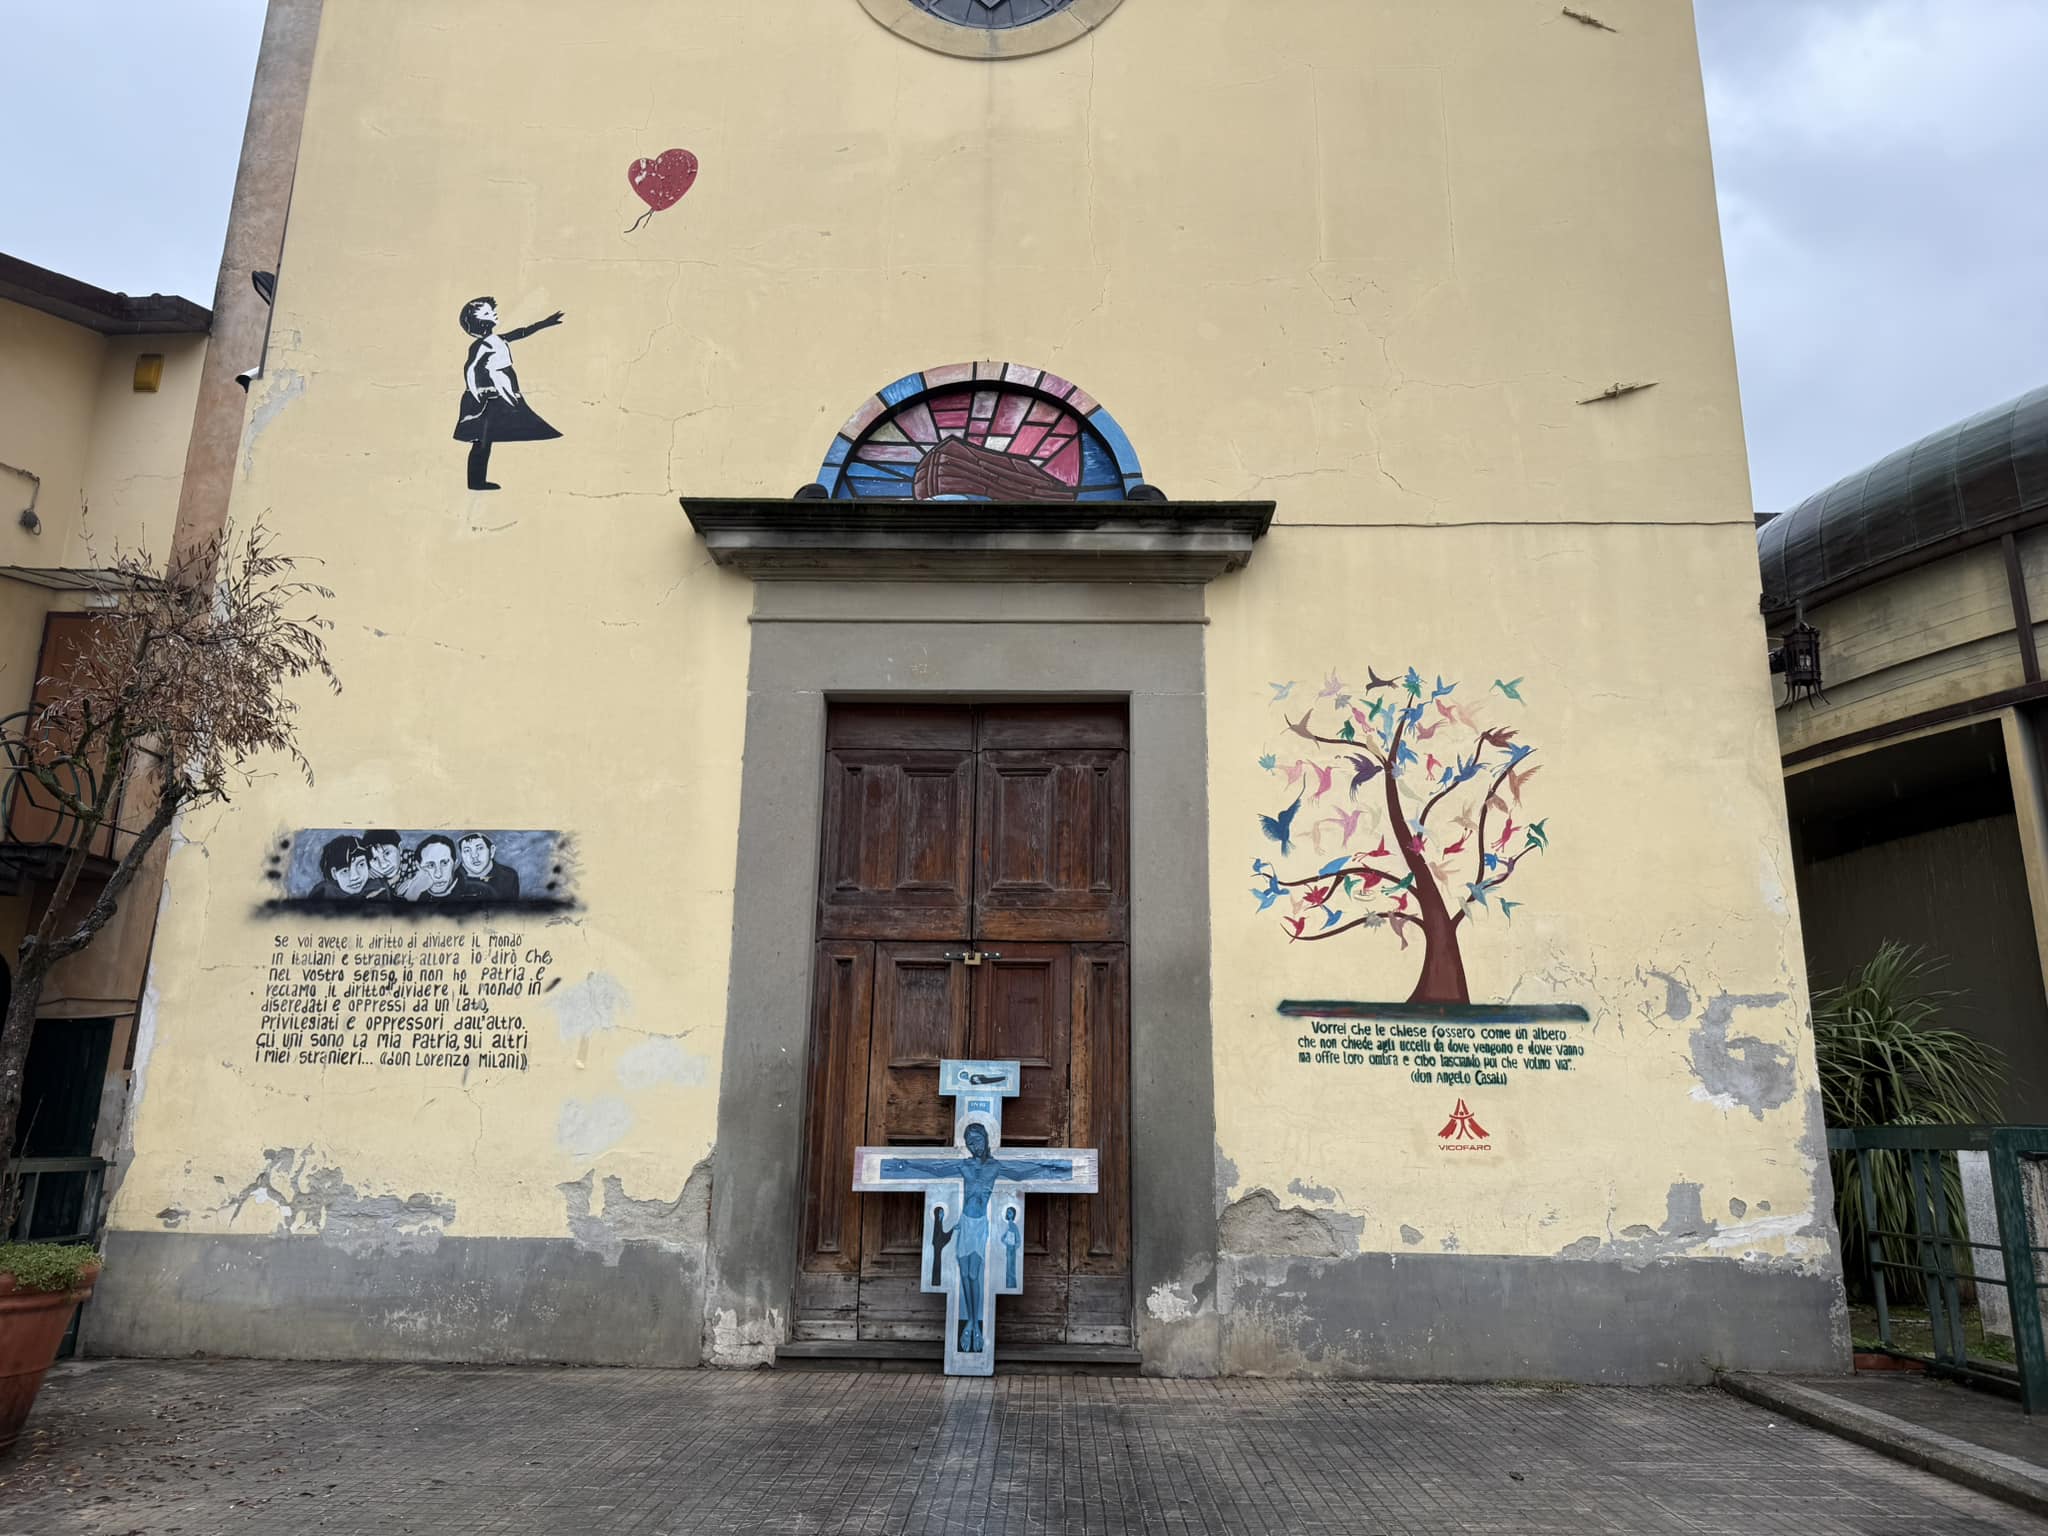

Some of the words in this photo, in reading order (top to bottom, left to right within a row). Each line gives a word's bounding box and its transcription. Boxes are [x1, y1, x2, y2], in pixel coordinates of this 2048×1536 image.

[298, 933, 313, 948] voi
[318, 936, 348, 951] avete
[368, 934, 403, 949] diritto
[407, 932, 417, 948] di
[422, 932, 465, 948] dividere
[271, 952, 284, 965] in
[291, 950, 336, 965] italiani
[341, 953, 349, 966] e
[419, 952, 460, 966] allora
[471, 951, 482, 965] io
[269, 968, 291, 981] nel
[302, 969, 344, 981] vostro
[403, 966, 413, 982] io
[420, 969, 443, 981] non
[453, 968, 467, 981] ho
[536, 966, 546, 981] e
[328, 982, 337, 997] il
[343, 982, 386, 998] diritto
[393, 981, 448, 998] dividere
[459, 979, 469, 996] il
[528, 976, 542, 996] in
[261, 998, 327, 1013] diseredati
[332, 999, 340, 1011] e
[412, 999, 428, 1012] da
[435, 998, 449, 1011] un
[346, 1016, 356, 1030] e
[366, 1013, 444, 1031] oppressori
[1312, 1021, 1346, 1035] Vorrei
[1351, 1023, 1371, 1036] che
[1376, 1024, 1385, 1036] le
[1390, 1025, 1426, 1037] chiese
[1432, 1025, 1475, 1038] fossero
[1481, 1027, 1511, 1039] come
[1516, 1028, 1527, 1040] un
[1533, 1028, 1566, 1040] albero
[283, 1030, 303, 1048] uni
[310, 1034, 344, 1047] sono
[353, 1034, 367, 1048] la
[464, 1032, 482, 1049] gli
[492, 1030, 528, 1049] altri
[1298, 1036, 1316, 1048] che
[1320, 1038, 1337, 1049] non
[1342, 1036, 1373, 1050] chiede
[1377, 1039, 1395, 1053] agli
[1400, 1039, 1430, 1052] uccelli
[1434, 1039, 1444, 1052] da
[1448, 1039, 1469, 1053] dove
[1473, 1042, 1513, 1056] vengono
[1517, 1044, 1523, 1054] e
[1528, 1041, 1552, 1055] dove
[1557, 1045, 1584, 1056] vanno
[416, 1052, 469, 1067] Lorenzo
[1316, 1051, 1340, 1063] offre
[1344, 1052, 1364, 1064] loro
[1369, 1053, 1398, 1065] ombra
[1403, 1055, 1409, 1065] e
[1415, 1054, 1436, 1067] cibo
[1441, 1054, 1480, 1068] lasciando
[1484, 1056, 1497, 1069] poi
[1502, 1056, 1517, 1068] che
[1523, 1057, 1550, 1070] volino
[1411, 1069, 1432, 1083] (don
[1437, 1071, 1471, 1086] Angelo
[1475, 1070, 1507, 1085] Casali)
